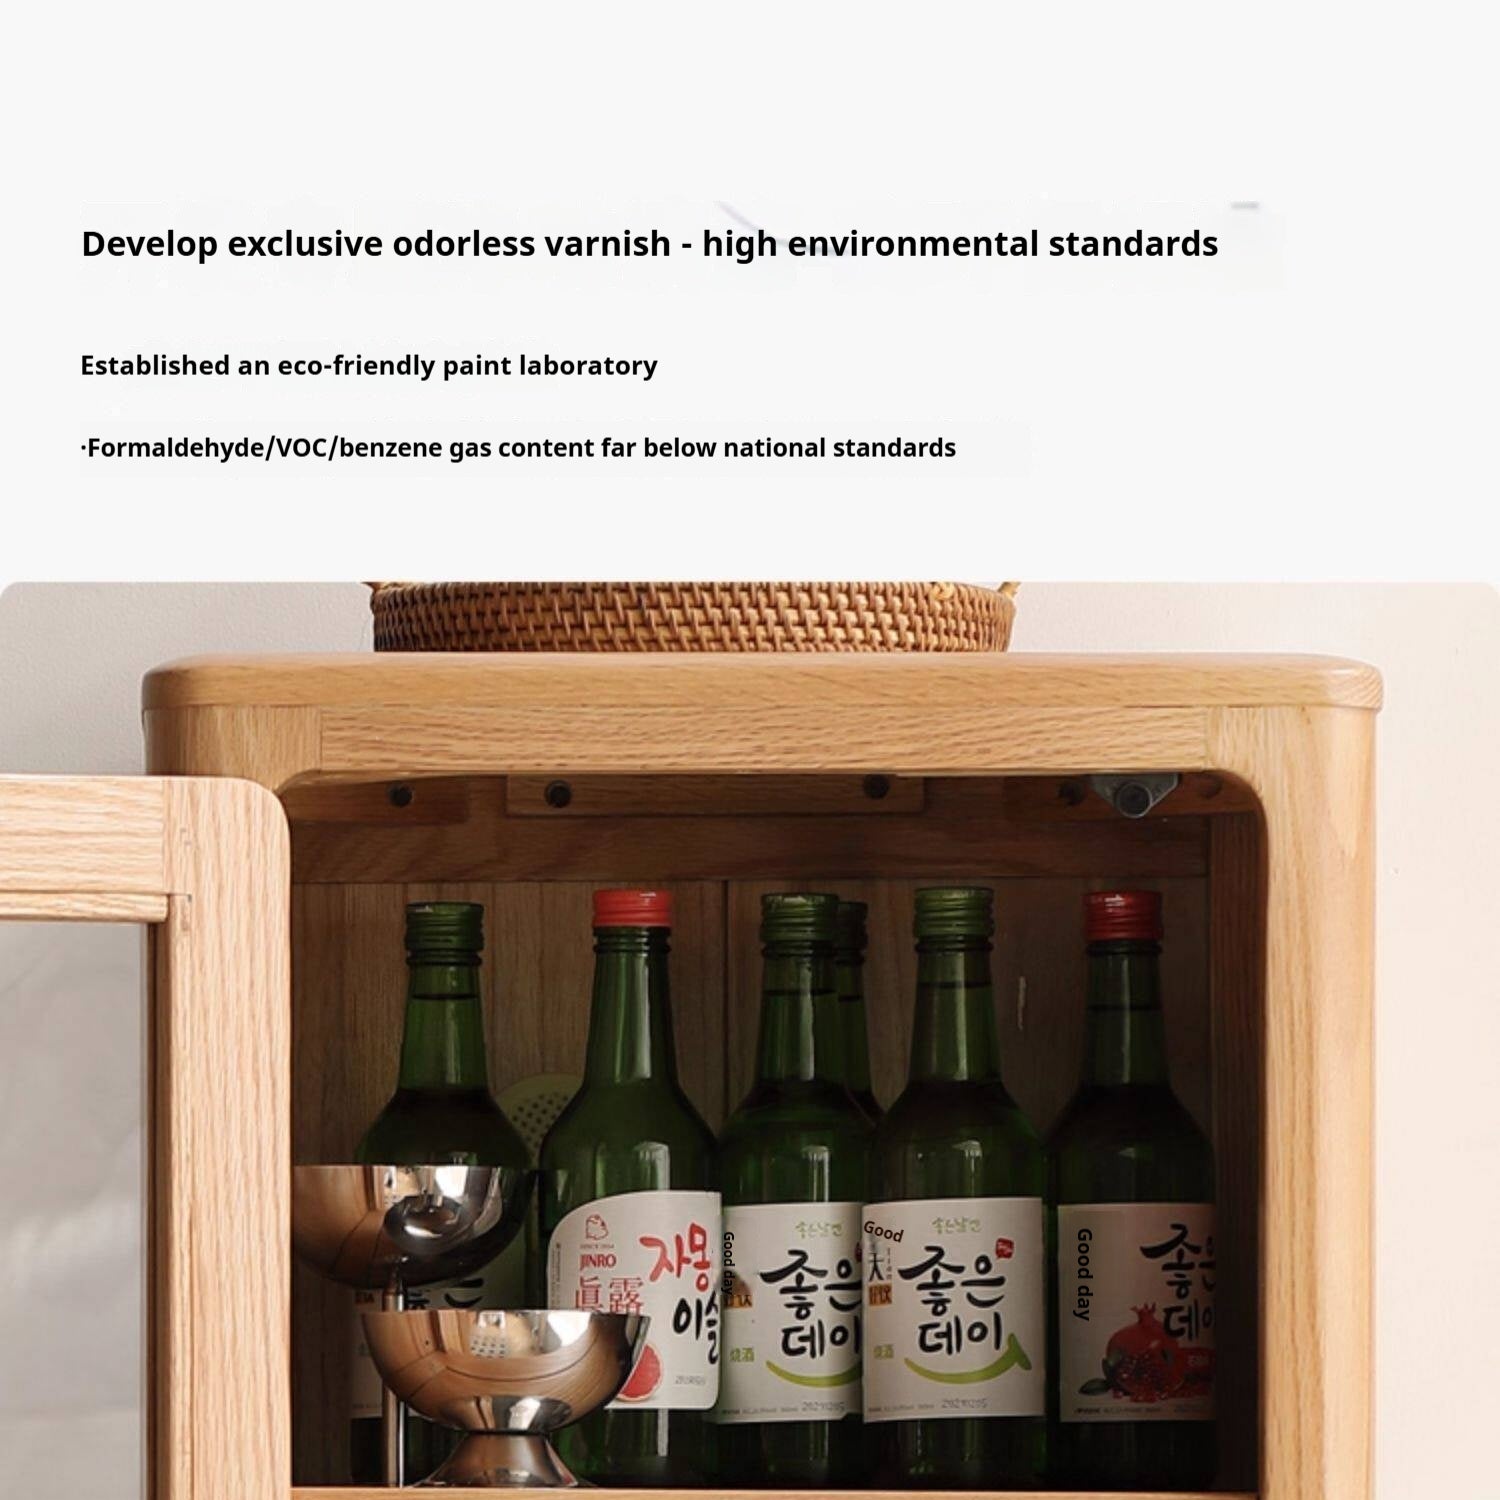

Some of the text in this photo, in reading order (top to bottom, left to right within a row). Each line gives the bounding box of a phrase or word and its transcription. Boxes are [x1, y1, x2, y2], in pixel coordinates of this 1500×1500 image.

[580, 1253, 616, 1271] JINRO
[640, 1222, 711, 1292] 자몽
[759, 1249, 862, 1320] 좋은
[898, 1245, 1006, 1316] 좋은
[673, 1290, 718, 1364] 이슬
[781, 1316, 862, 1360] 데이
[918, 1312, 1001, 1355] 데이
